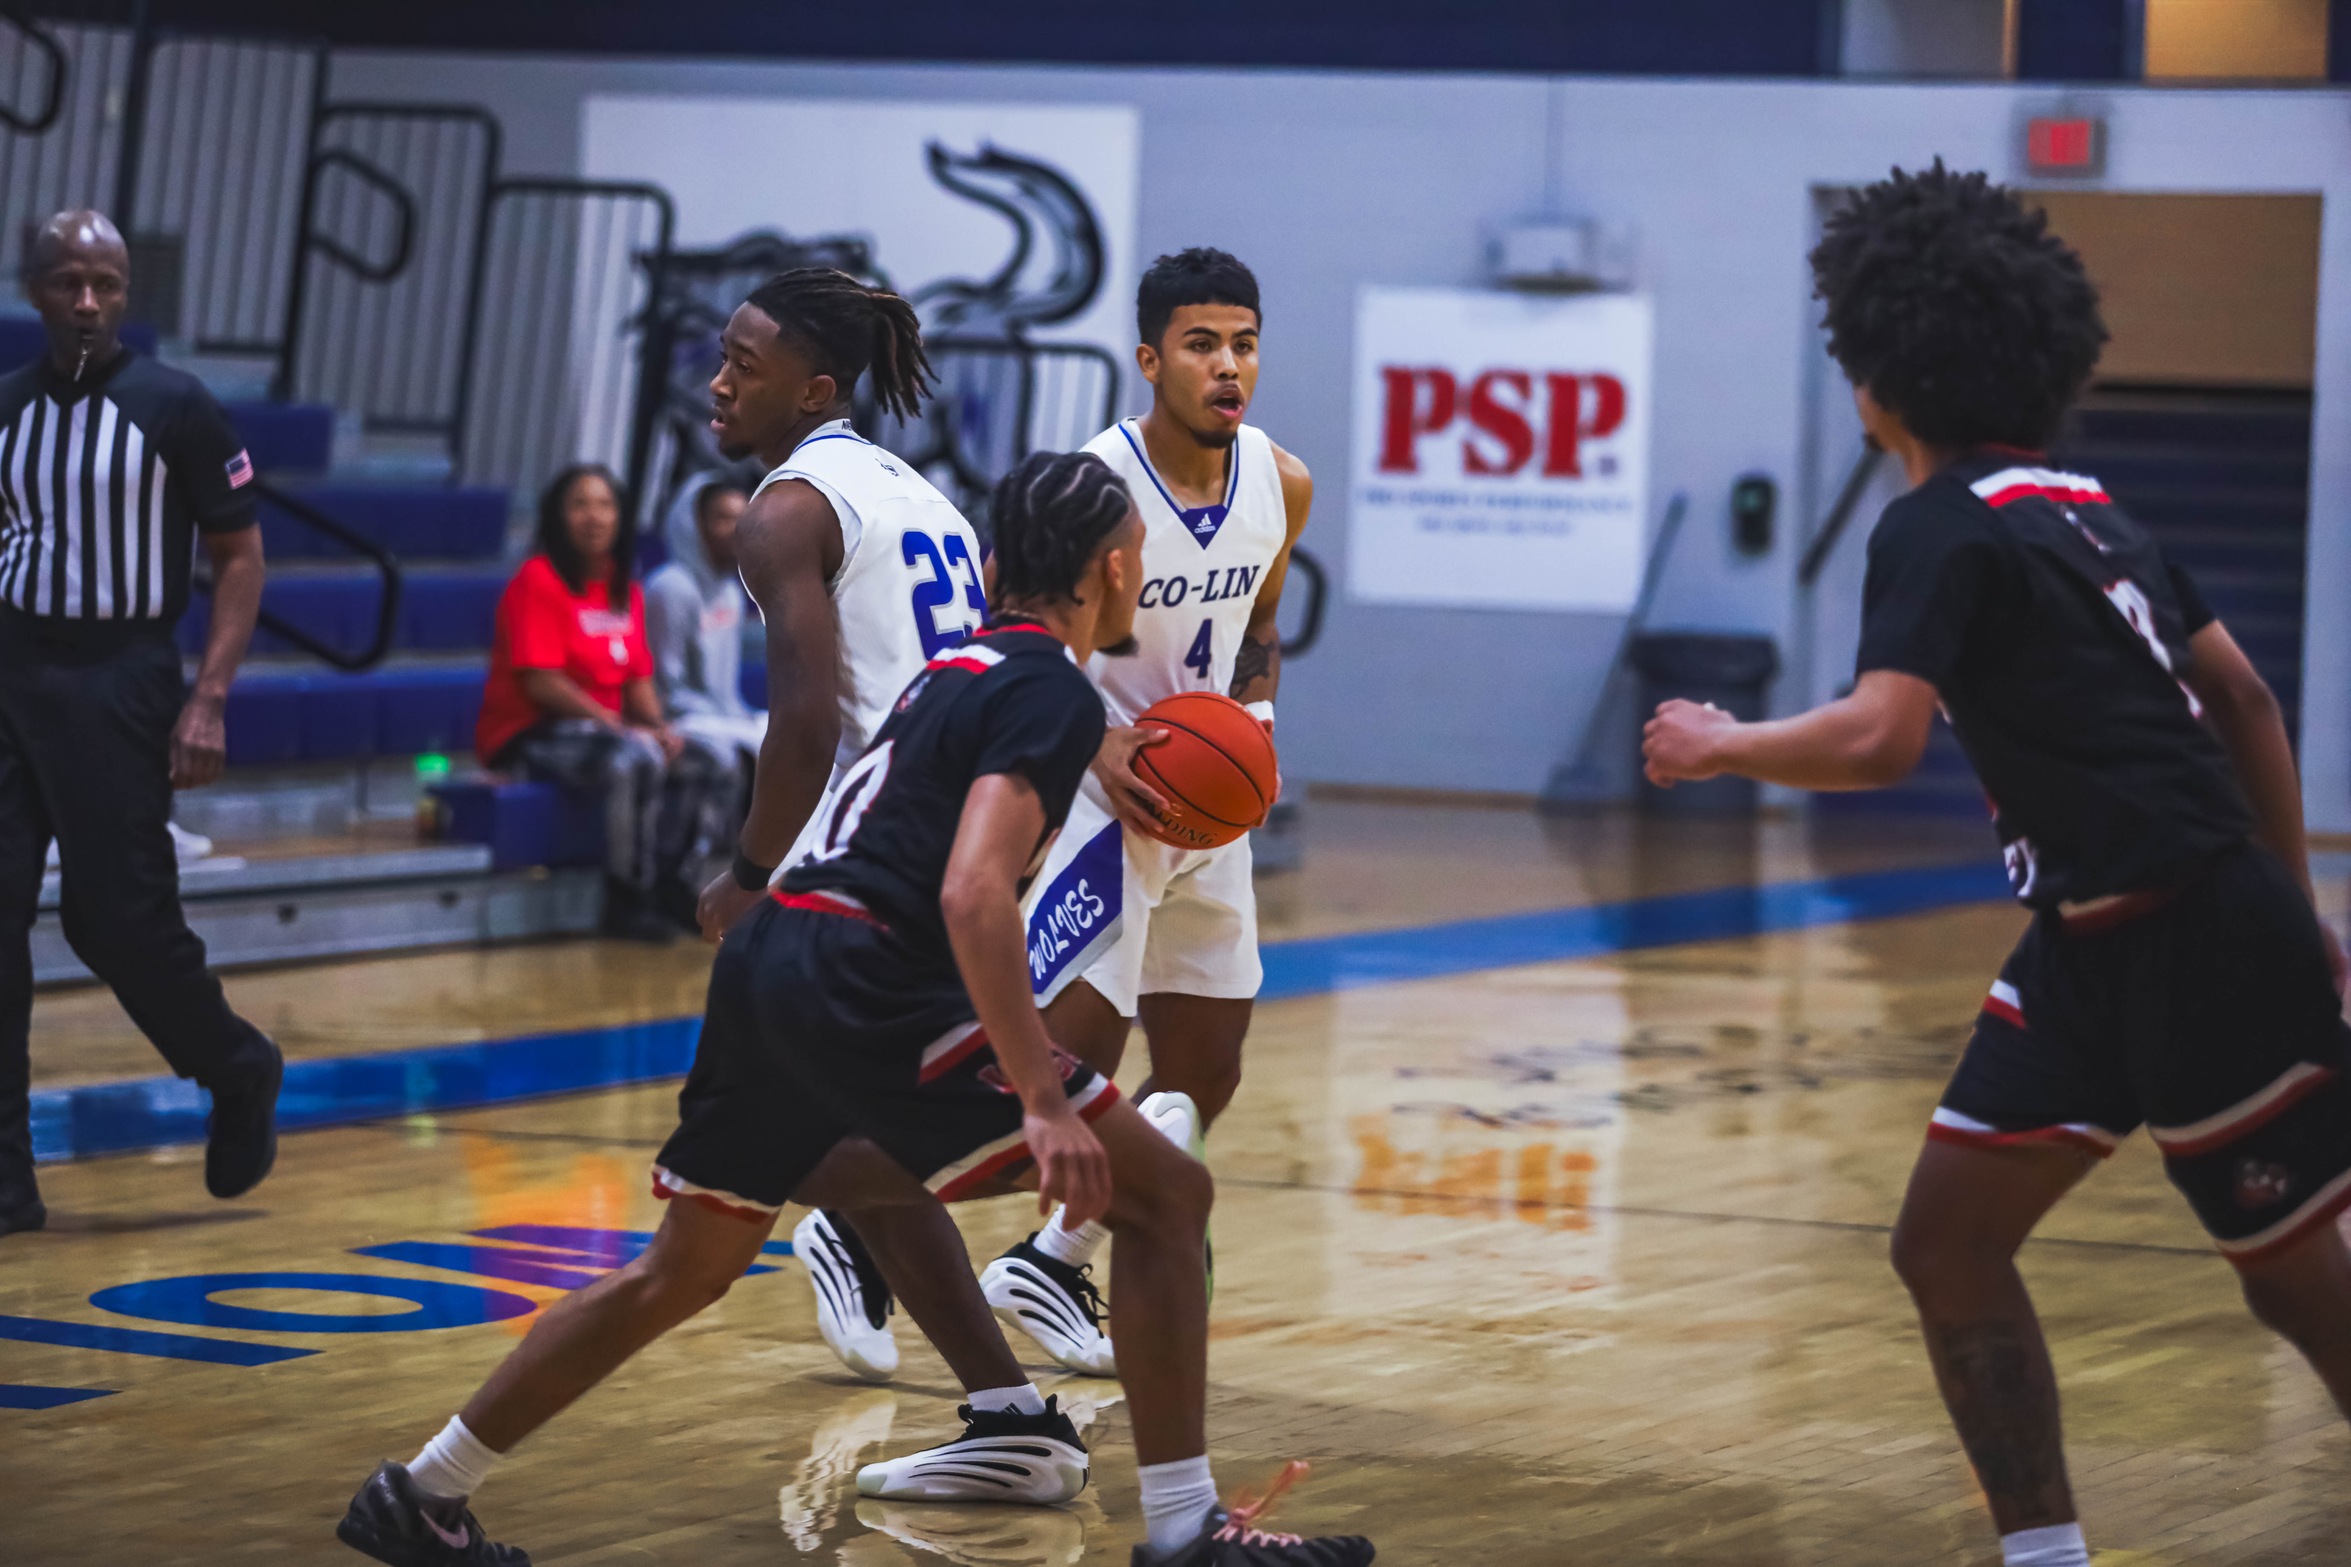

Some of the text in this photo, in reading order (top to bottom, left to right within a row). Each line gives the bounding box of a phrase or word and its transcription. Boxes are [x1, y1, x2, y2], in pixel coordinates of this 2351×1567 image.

[1378, 365, 1626, 478] PSP
[901, 529, 991, 662] 23
[1138, 565, 1260, 608] CO-LIN
[1184, 618, 1212, 679] 4
[1029, 878, 1104, 980] WOLVES
